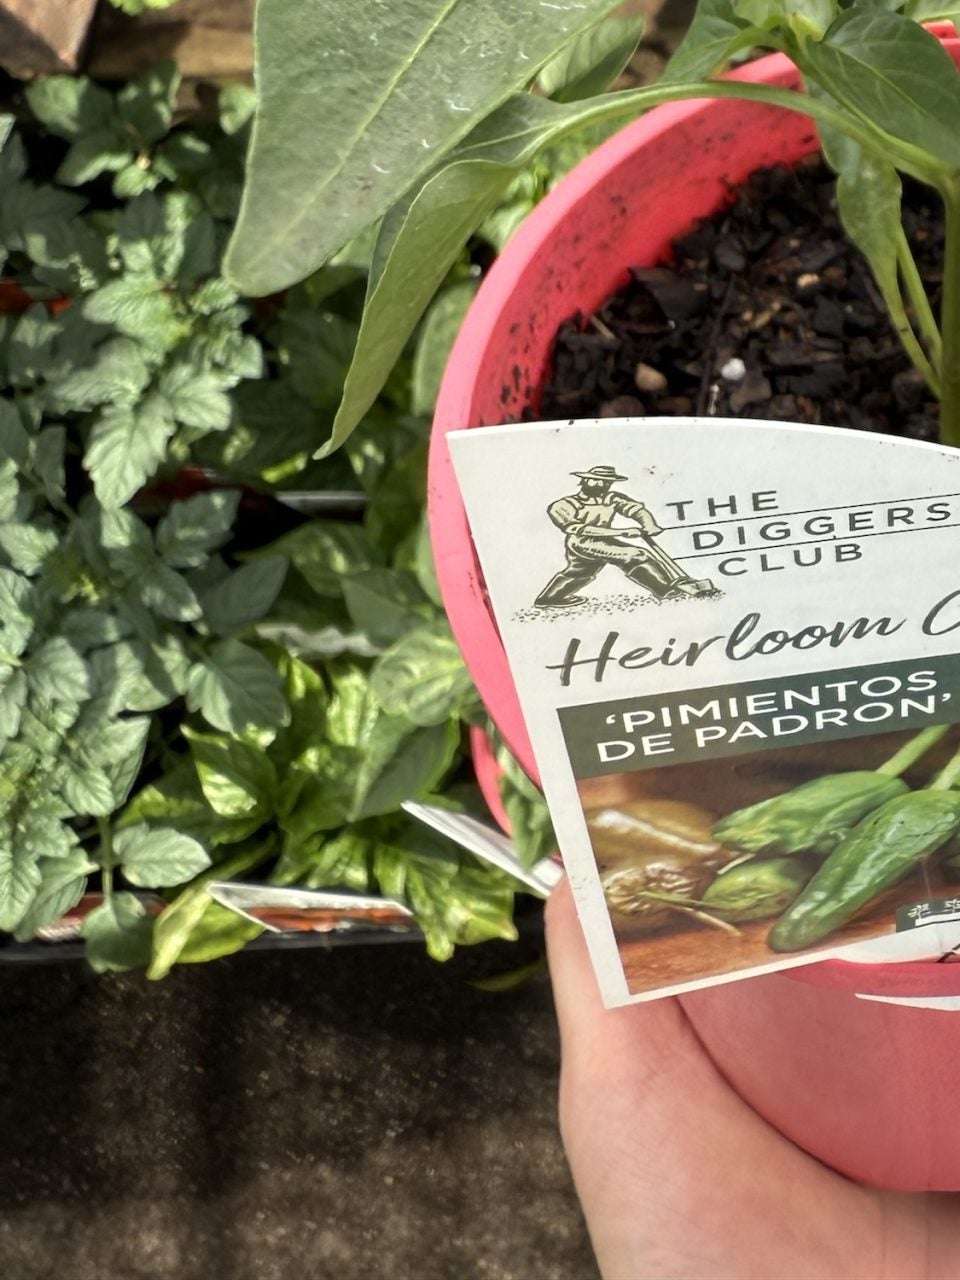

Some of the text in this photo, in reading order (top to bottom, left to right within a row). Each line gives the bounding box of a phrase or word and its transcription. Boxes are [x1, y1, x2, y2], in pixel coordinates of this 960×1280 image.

[666, 490, 779, 521] THE
[692, 502, 951, 550] DIGGERS
[718, 543, 862, 576] CLUB
[546, 612, 907, 686] Heirloom
[597, 732, 675, 763] DE
